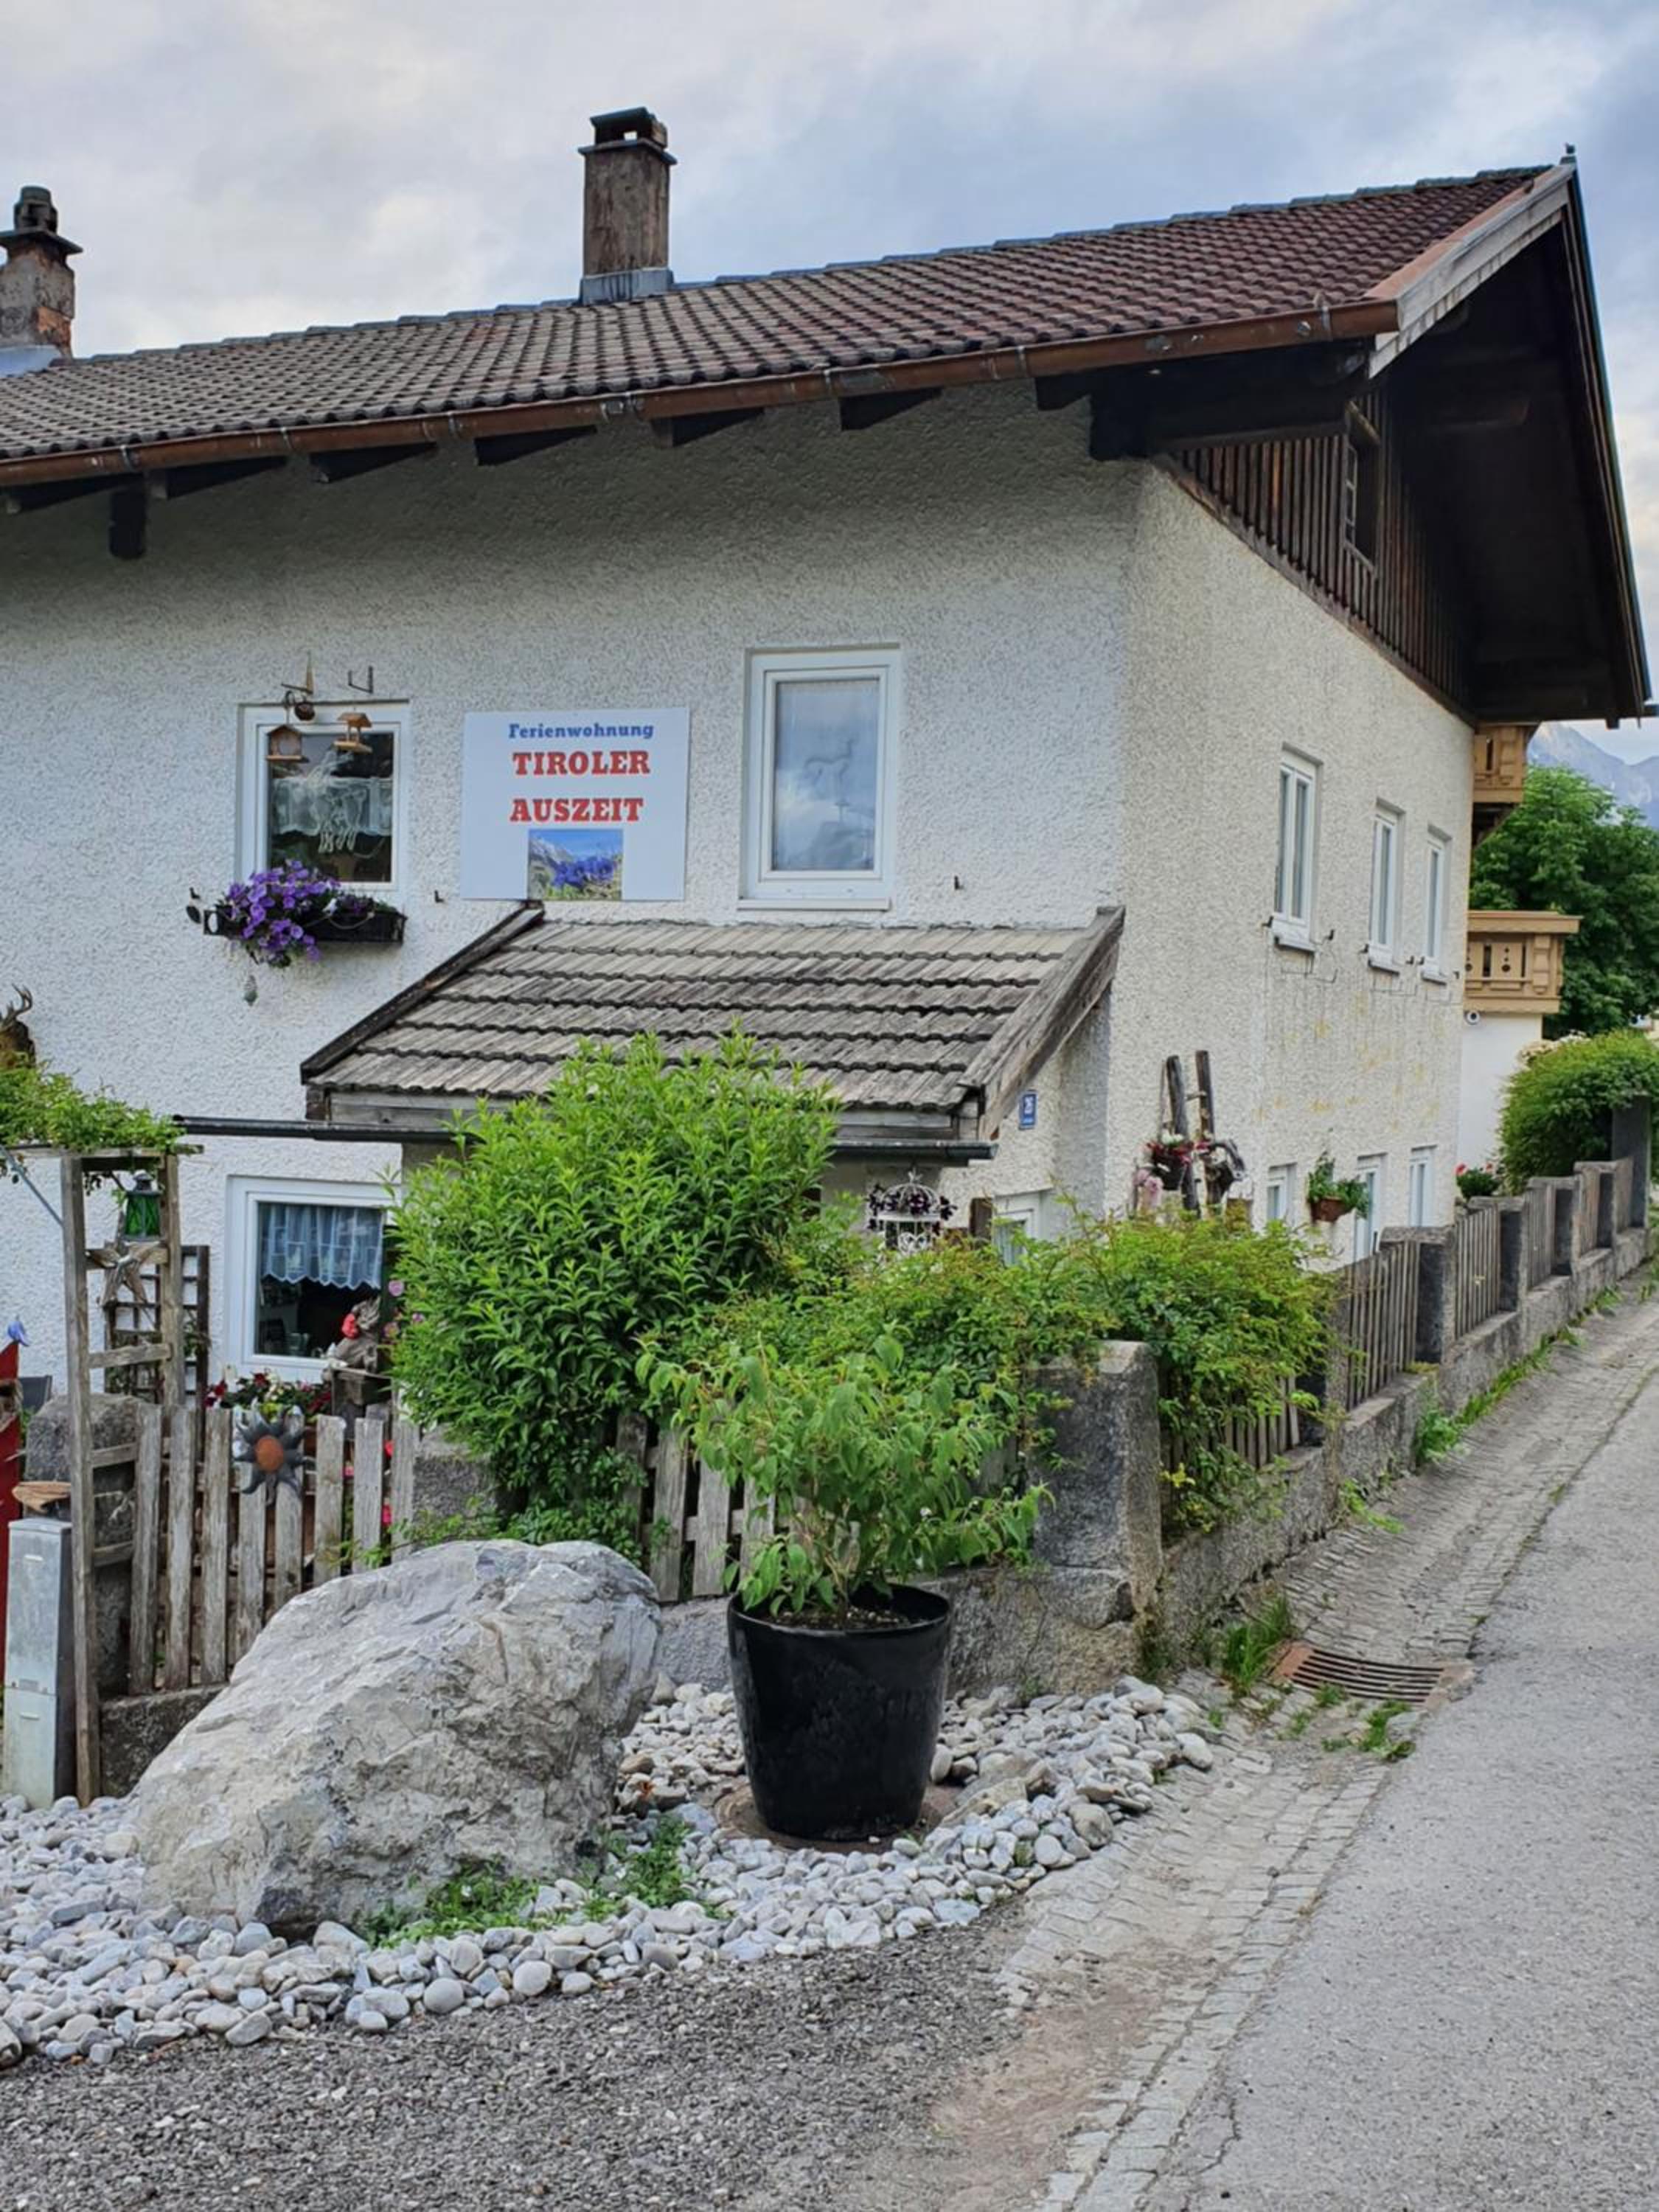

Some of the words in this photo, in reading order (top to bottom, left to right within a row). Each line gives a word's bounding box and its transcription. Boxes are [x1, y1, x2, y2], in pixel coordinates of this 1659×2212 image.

[509, 723, 654, 739] Ferienwohnung
[512, 751, 650, 775] TIROLER
[509, 798, 644, 822] AUSZEIT
